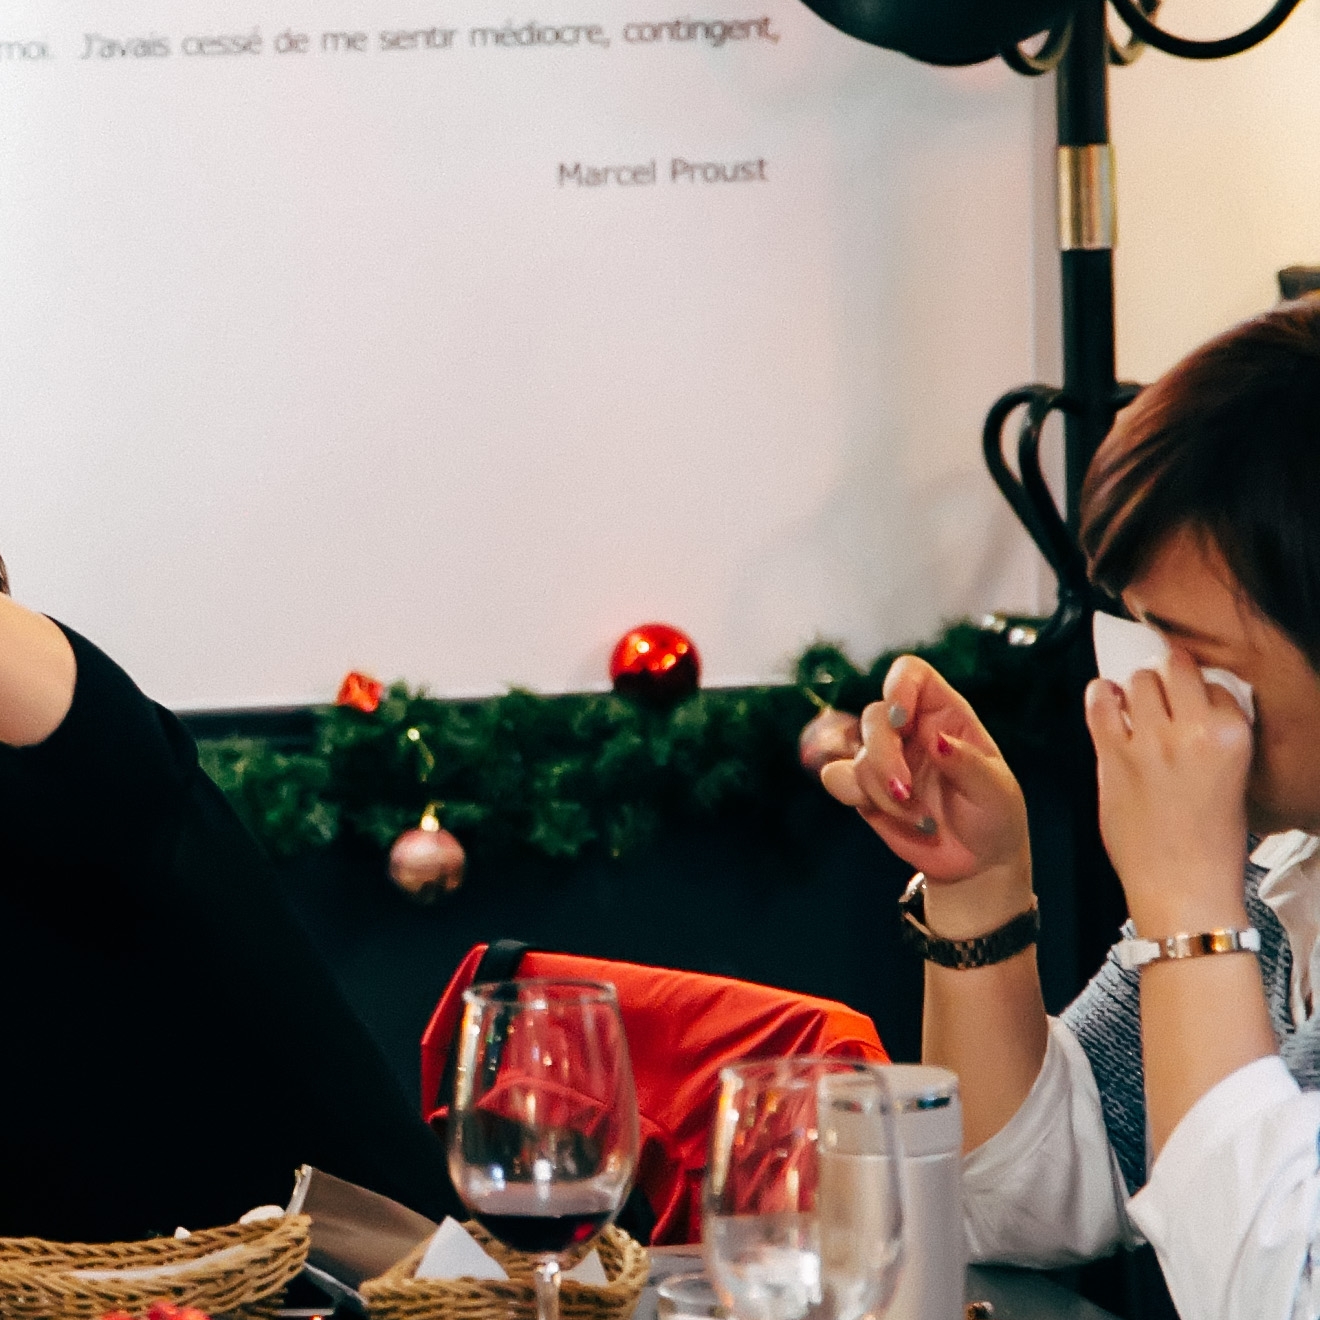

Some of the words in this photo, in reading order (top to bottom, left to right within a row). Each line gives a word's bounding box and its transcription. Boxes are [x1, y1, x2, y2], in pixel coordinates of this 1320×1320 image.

[81, 31, 170, 61] J'avais
[181, 25, 263, 57] cessé
[274, 27, 310, 55] de
[321, 28, 368, 52] me
[380, 23, 458, 52] sentir
[469, 17, 610, 50] médiocre,
[622, 15, 780, 49] contingent,
[557, 158, 657, 188] Marcel
[670, 156, 770, 184] Proust
